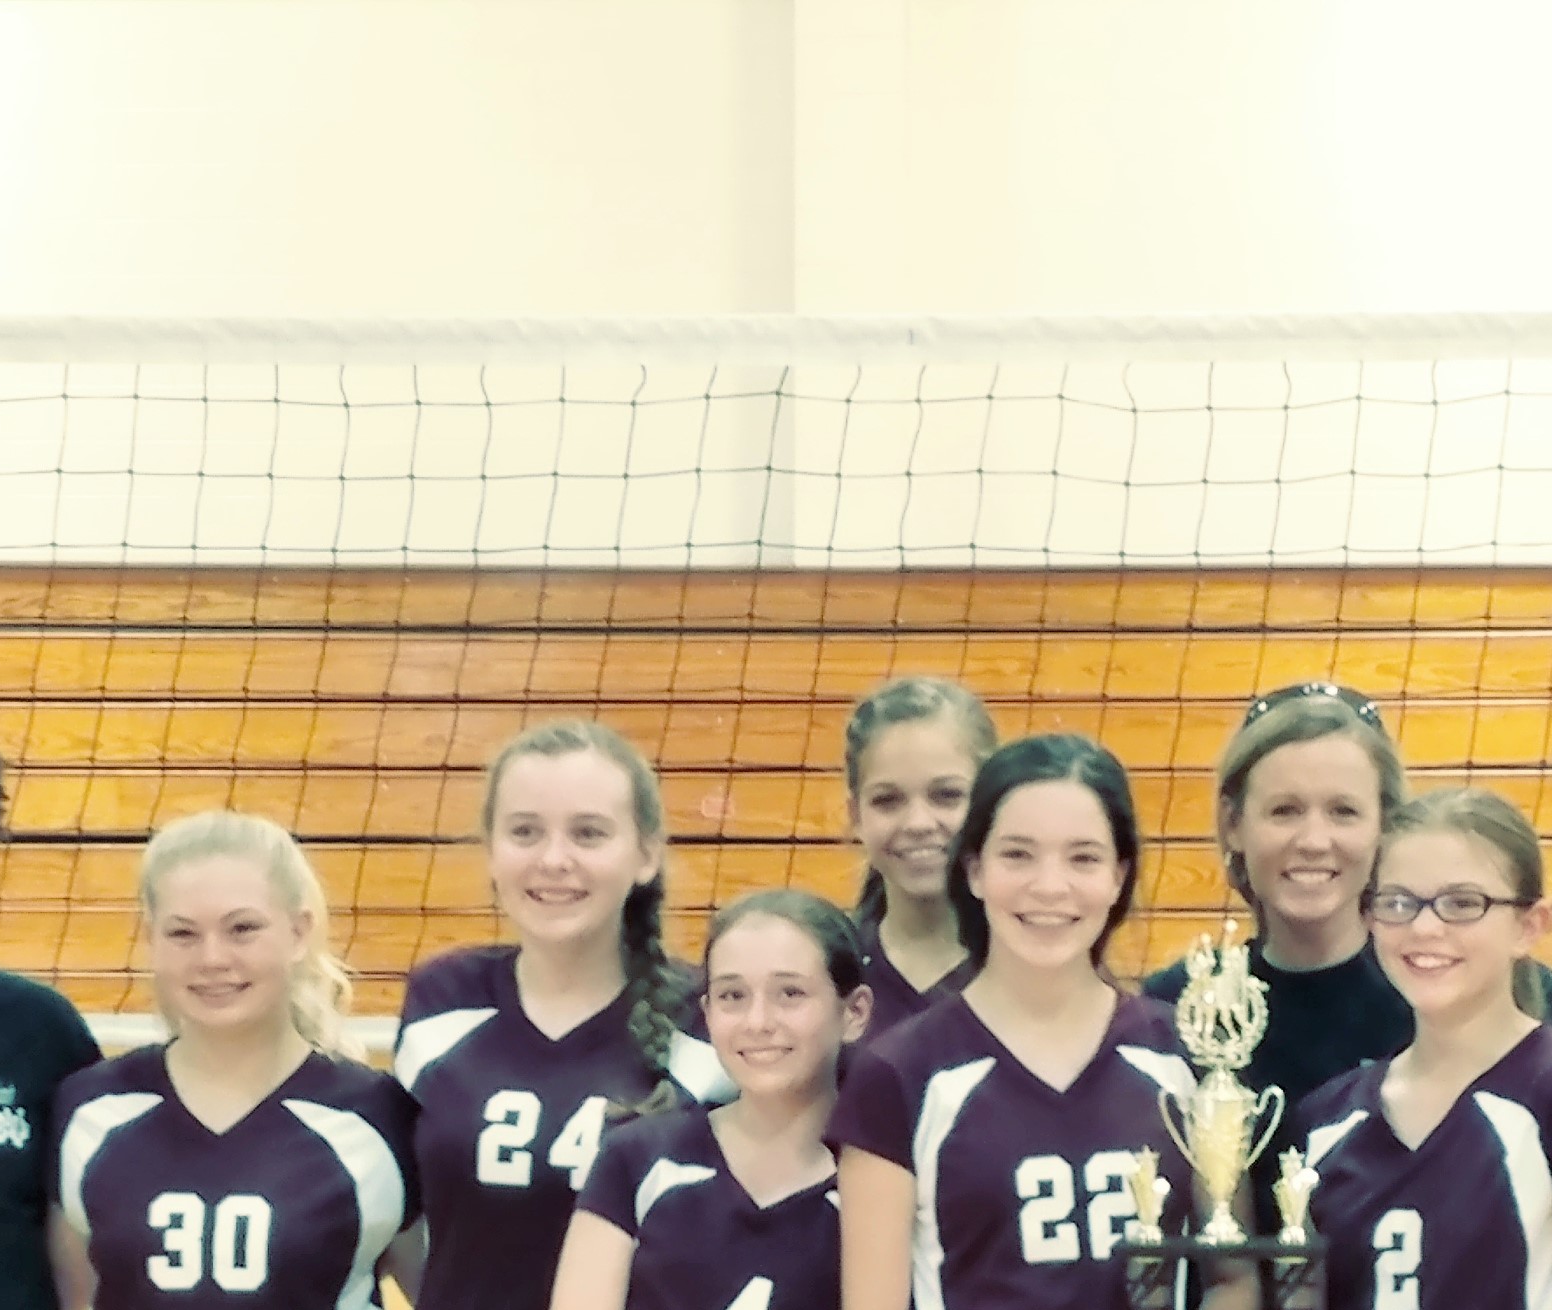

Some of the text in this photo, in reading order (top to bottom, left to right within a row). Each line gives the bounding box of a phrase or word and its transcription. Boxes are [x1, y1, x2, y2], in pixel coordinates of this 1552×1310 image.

[477, 1089, 608, 1191] 24
[147, 1190, 273, 1292] 30
[1015, 1150, 1141, 1264] 22
